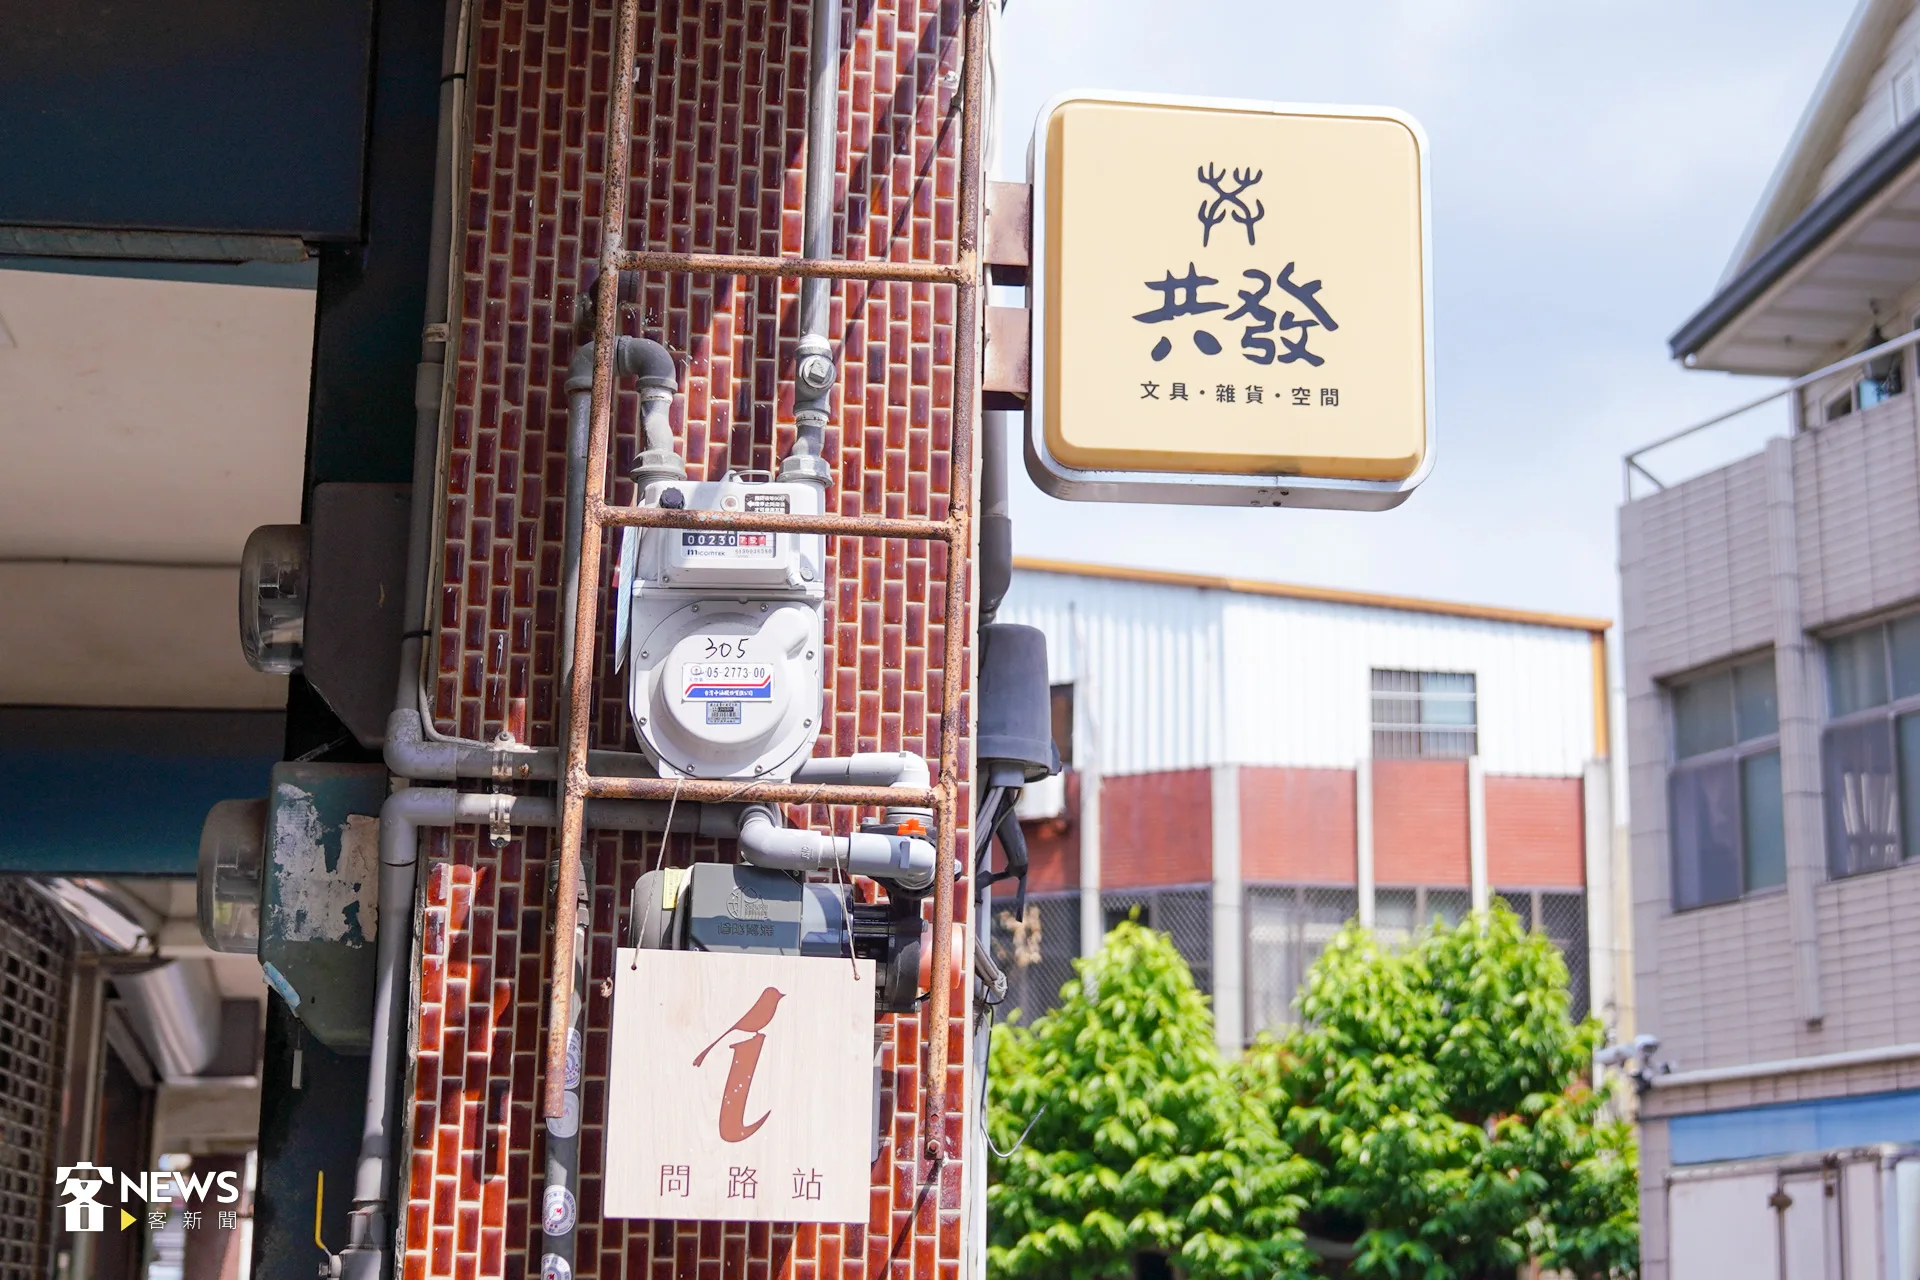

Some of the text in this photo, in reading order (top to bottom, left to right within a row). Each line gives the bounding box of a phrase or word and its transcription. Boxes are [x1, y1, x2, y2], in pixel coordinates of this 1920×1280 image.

[1131, 261, 1340, 368] 共發
[705, 637, 750, 660] 305
[706, 666, 765, 679] 05-2773-00
[659, 1163, 824, 1202] 問路站
